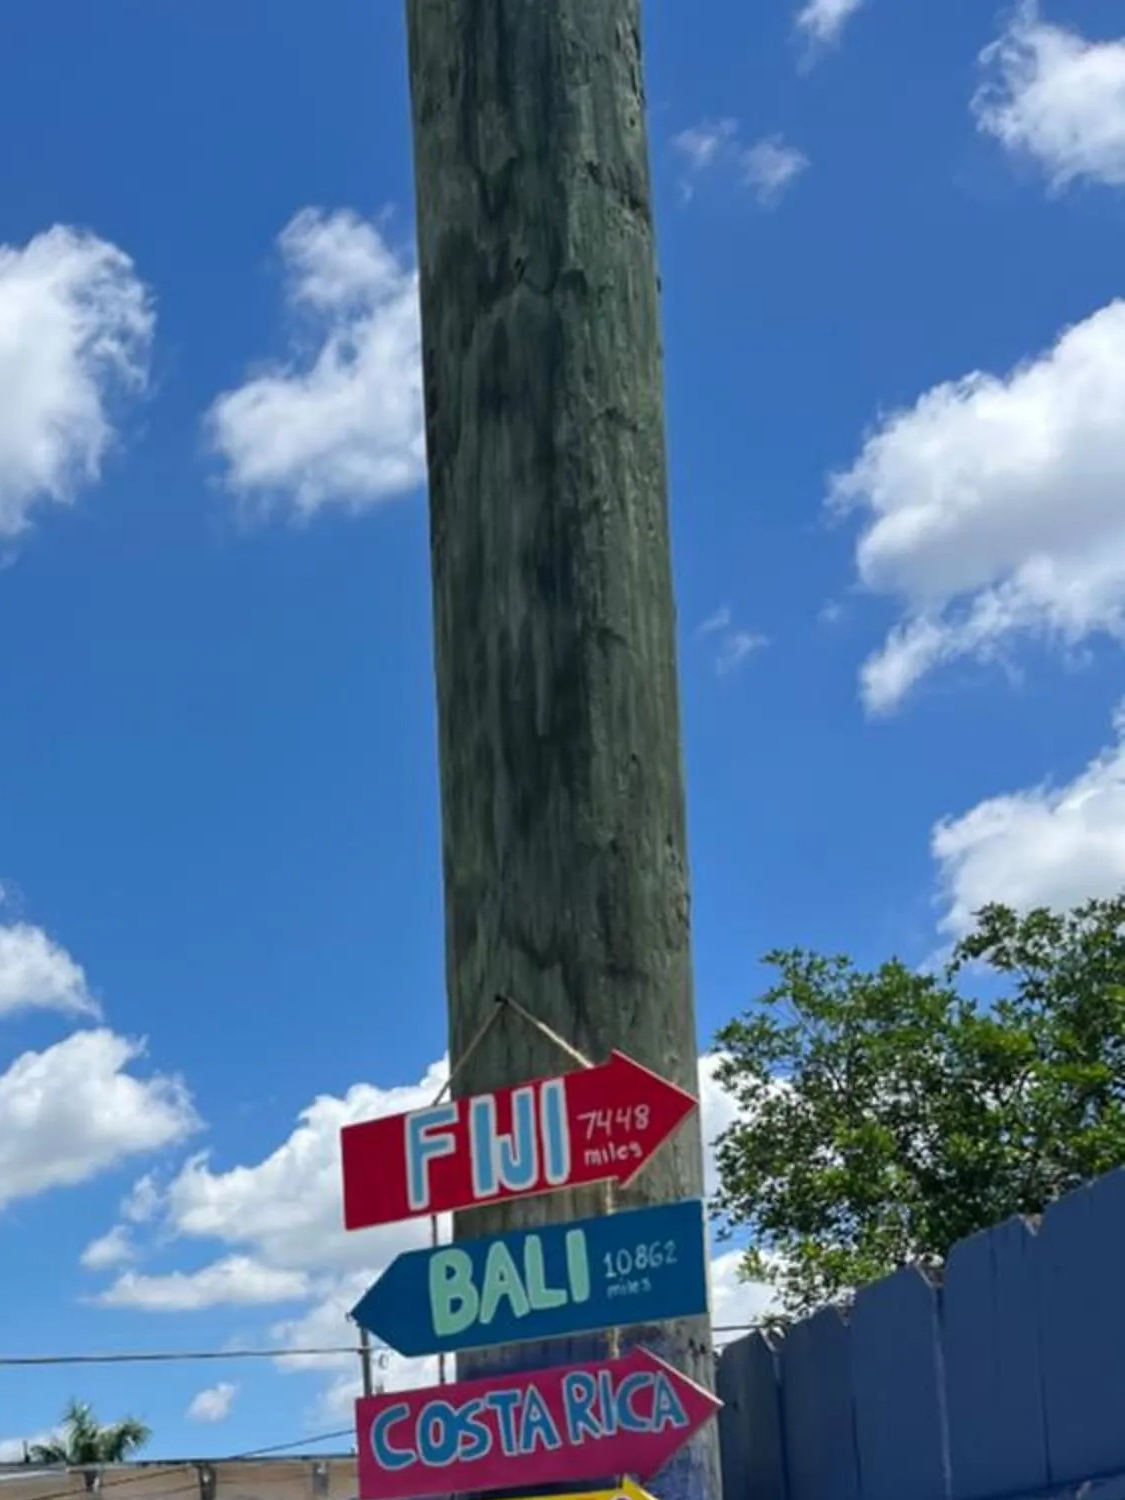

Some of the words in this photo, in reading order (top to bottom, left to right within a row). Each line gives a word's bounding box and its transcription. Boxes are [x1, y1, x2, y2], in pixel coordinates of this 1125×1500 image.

[577, 1104, 650, 1139] 7448
[406, 1078, 570, 1210] FIJI
[584, 1141, 642, 1166] miles
[603, 1240, 678, 1278] 10862
[429, 1229, 590, 1336] BALI
[607, 1278, 652, 1300] miles
[371, 1384, 560, 1471] COSTA
[562, 1370, 688, 1446] RICA
